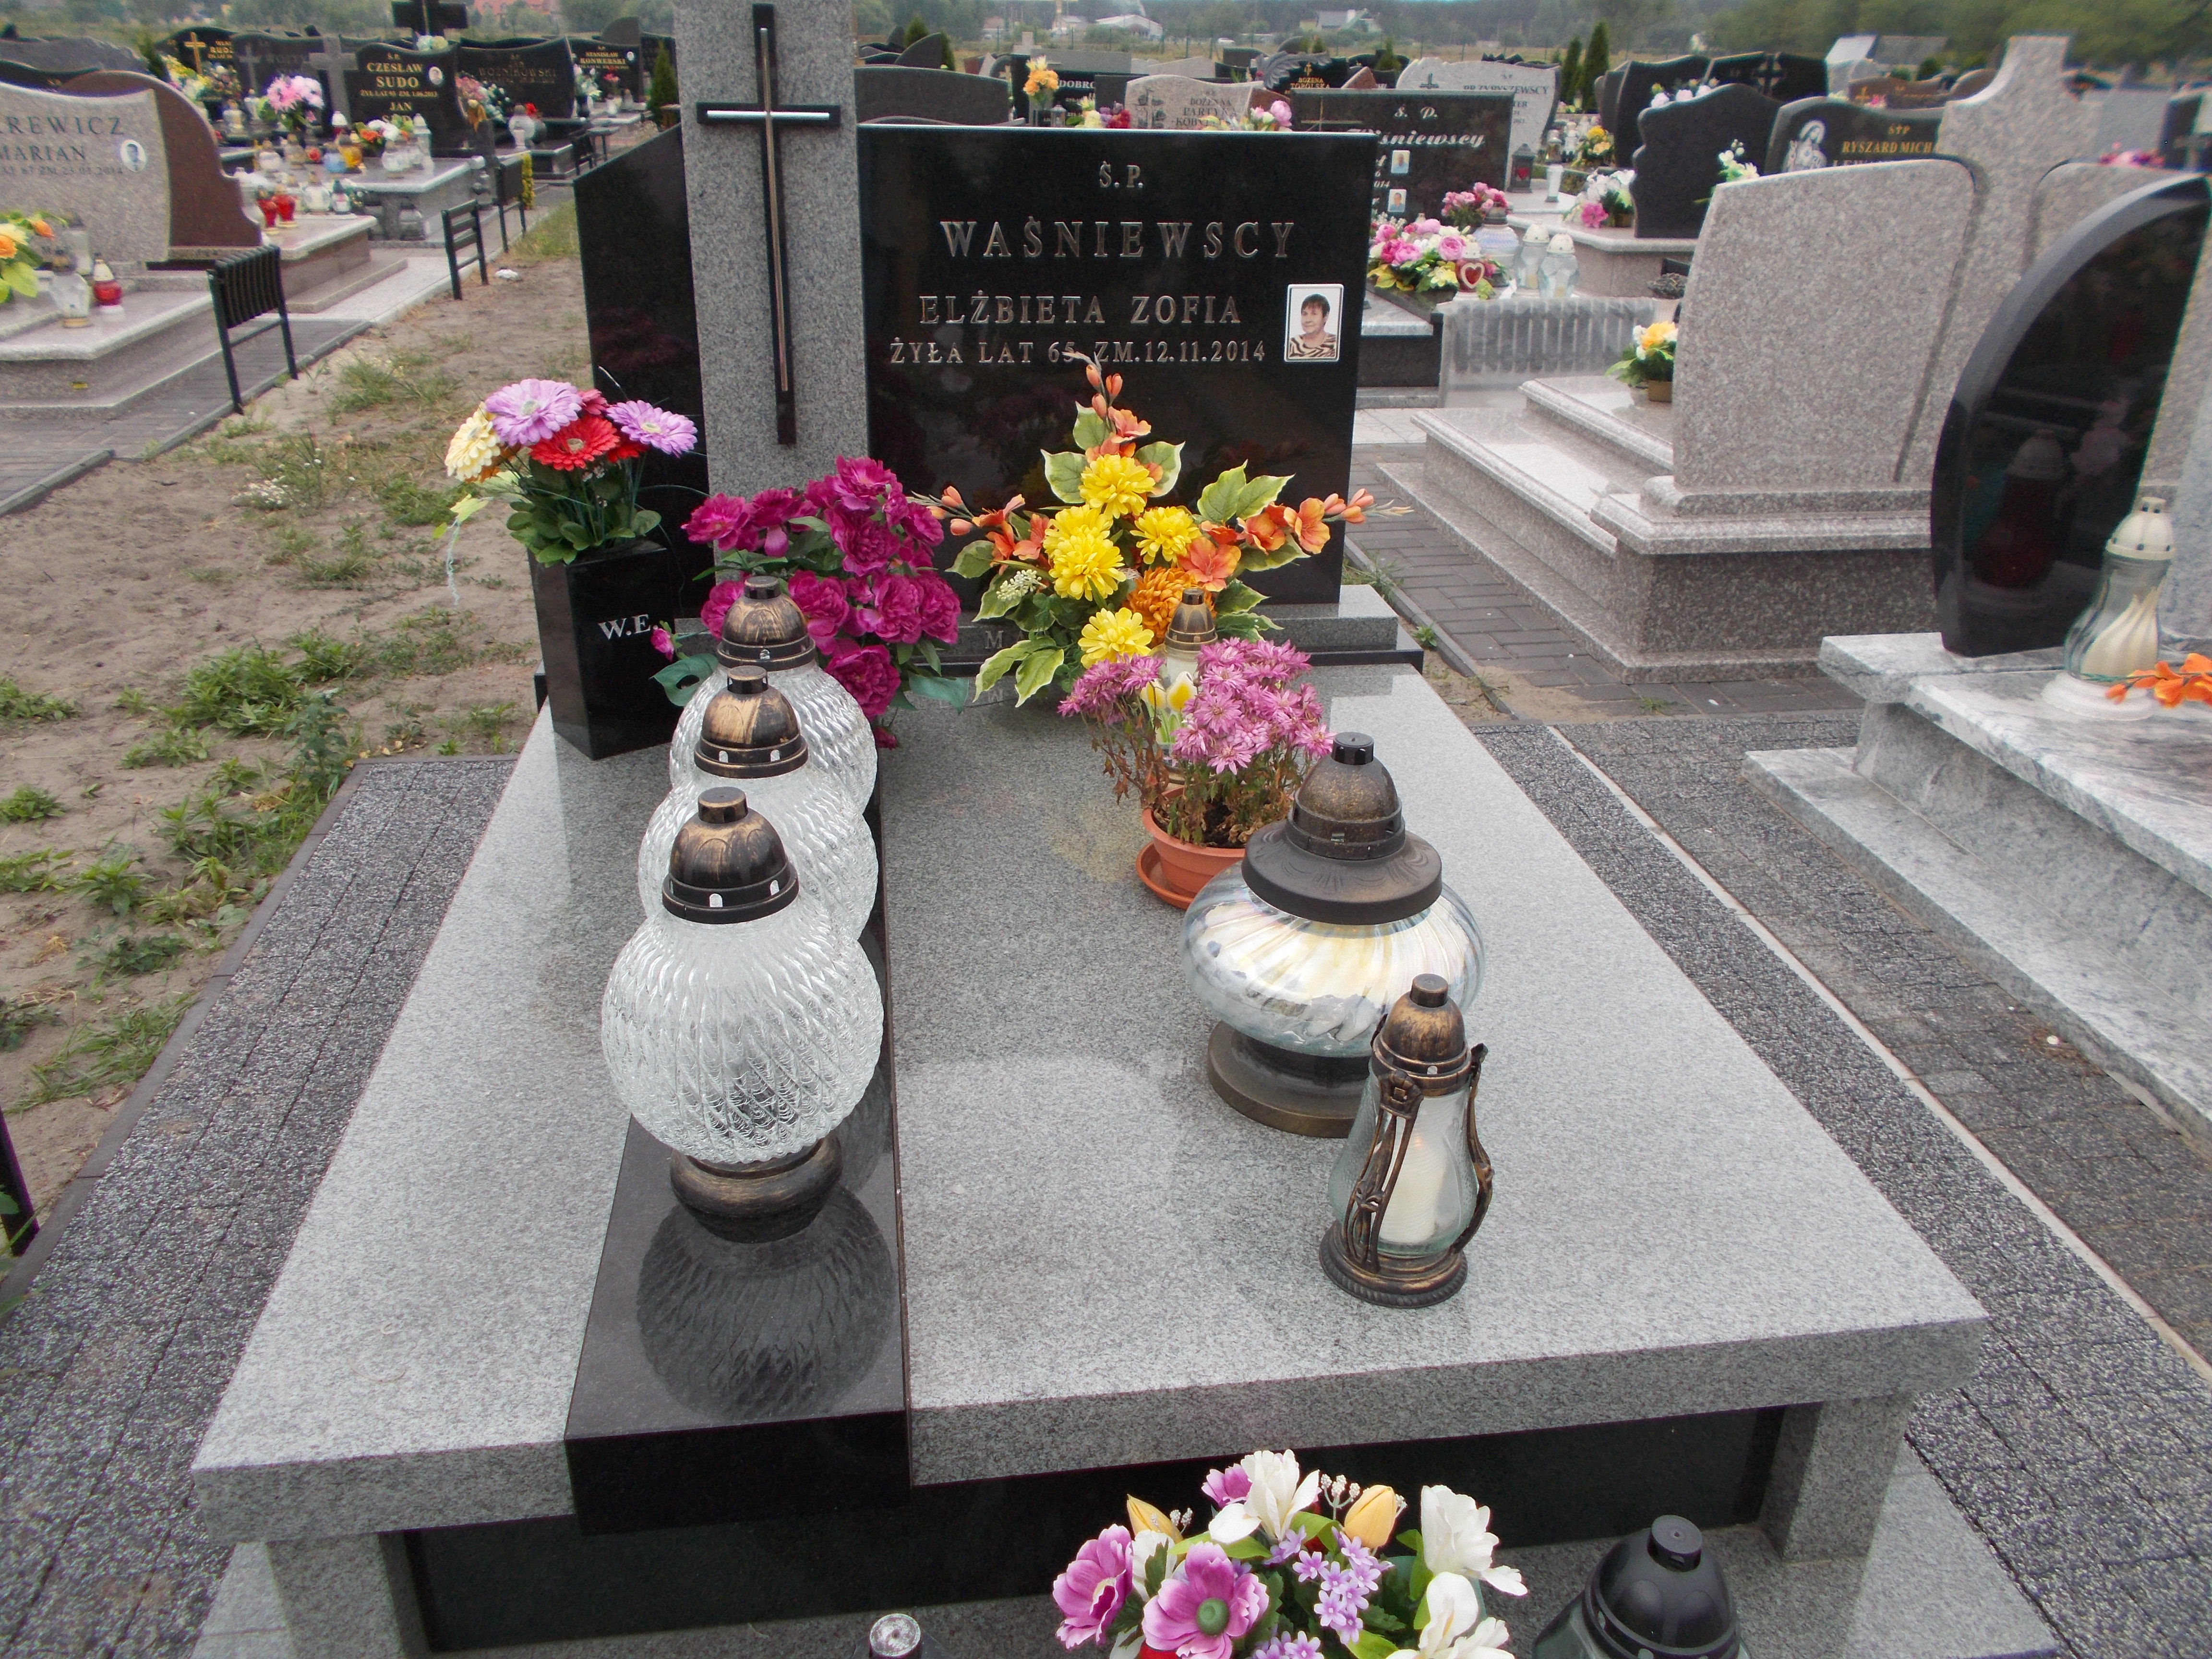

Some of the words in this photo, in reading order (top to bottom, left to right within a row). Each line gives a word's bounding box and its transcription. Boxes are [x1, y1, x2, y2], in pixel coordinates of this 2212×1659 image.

[376, 76, 419, 88] SUDO
[390, 102, 412, 111] JAN
[1842, 141, 1898, 153] RYSZARD
[940, 216, 1295, 258] WAŚNIEWSCY
[919, 290, 1106, 324] ELŻBIETA
[1130, 295, 1241, 324] ZOFIA
[890, 337, 963, 363] ŻYŁA
[978, 342, 1034, 363] LAT
